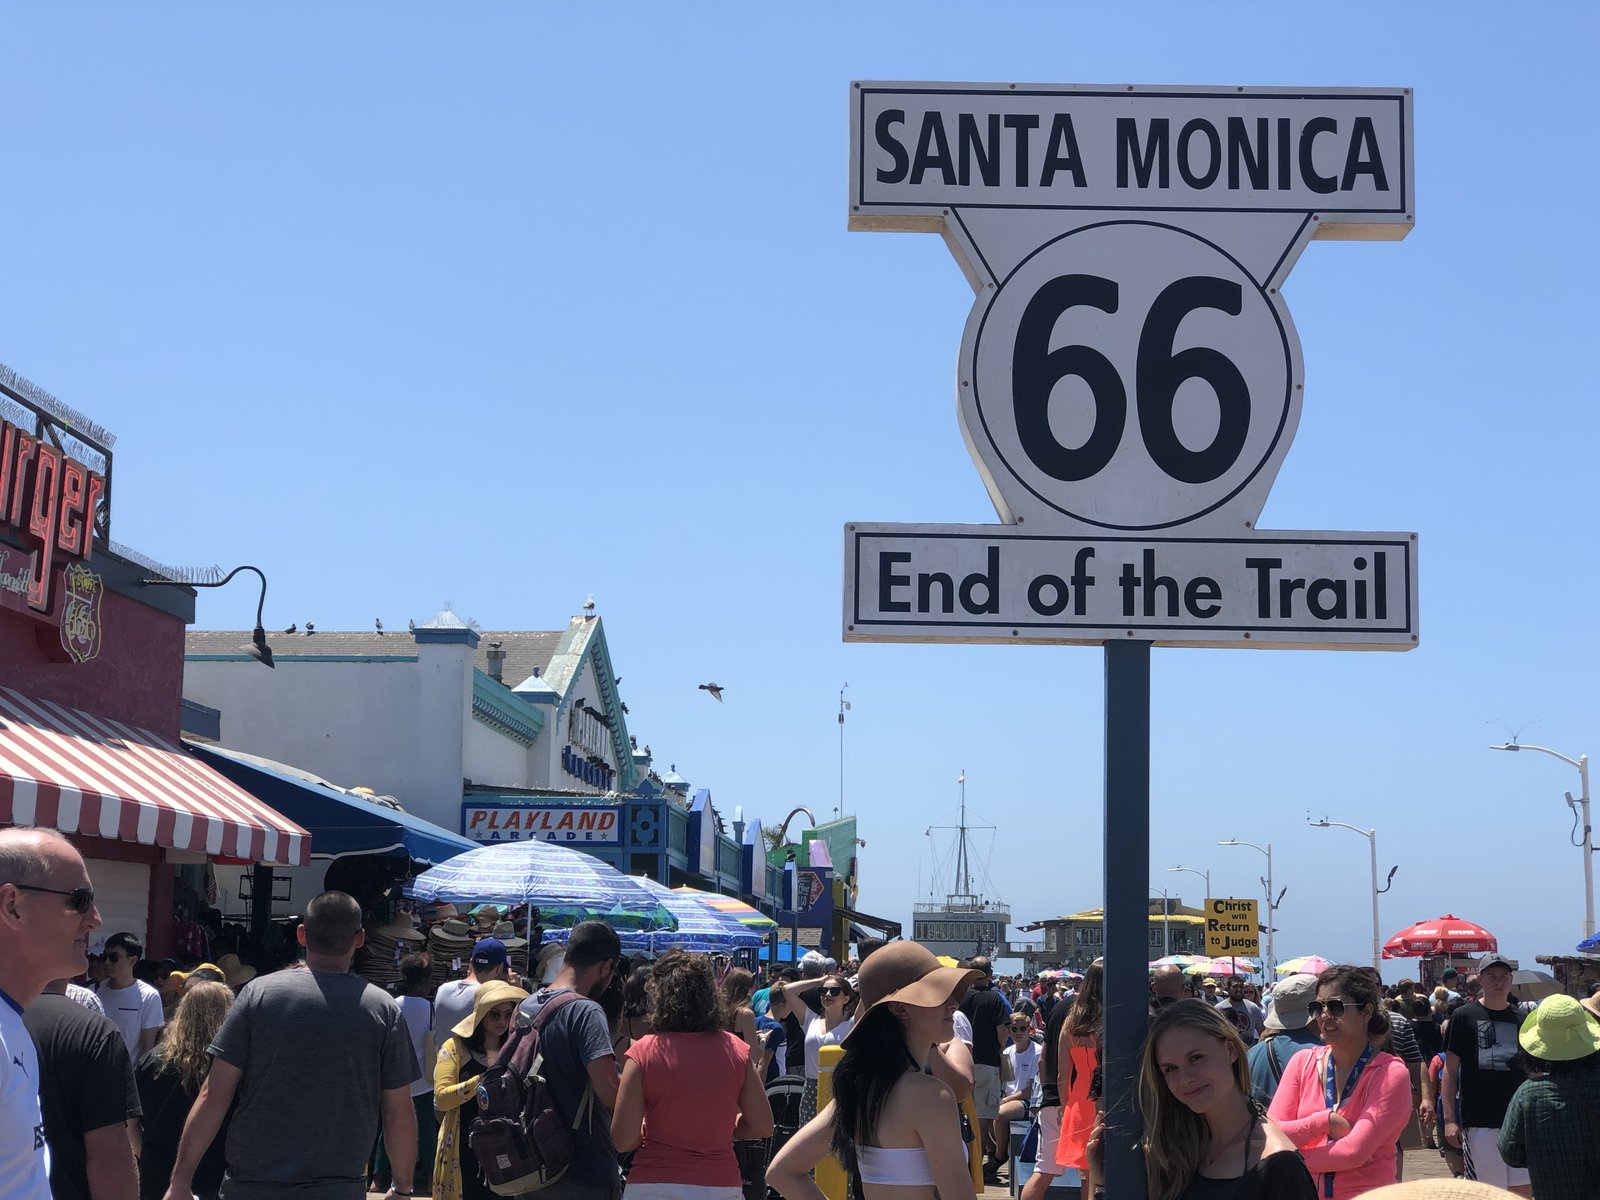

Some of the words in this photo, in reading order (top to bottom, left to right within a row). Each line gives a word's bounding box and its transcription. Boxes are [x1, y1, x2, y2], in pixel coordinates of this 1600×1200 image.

[874, 108, 1088, 188] SANTA
[1115, 115, 1390, 194] MONICA
[1011, 273, 1252, 484] 66
[877, 545, 999, 615] End
[1027, 546, 1096, 616] of
[1118, 548, 1223, 619] the
[1245, 551, 1388, 621] Trail
[469, 810, 616, 831] PLAYLAND
[1213, 899, 1252, 914] Christ
[1207, 918, 1250, 932] Return
[1210, 936, 1221, 945] to
[1221, 935, 1258, 950] Judge
